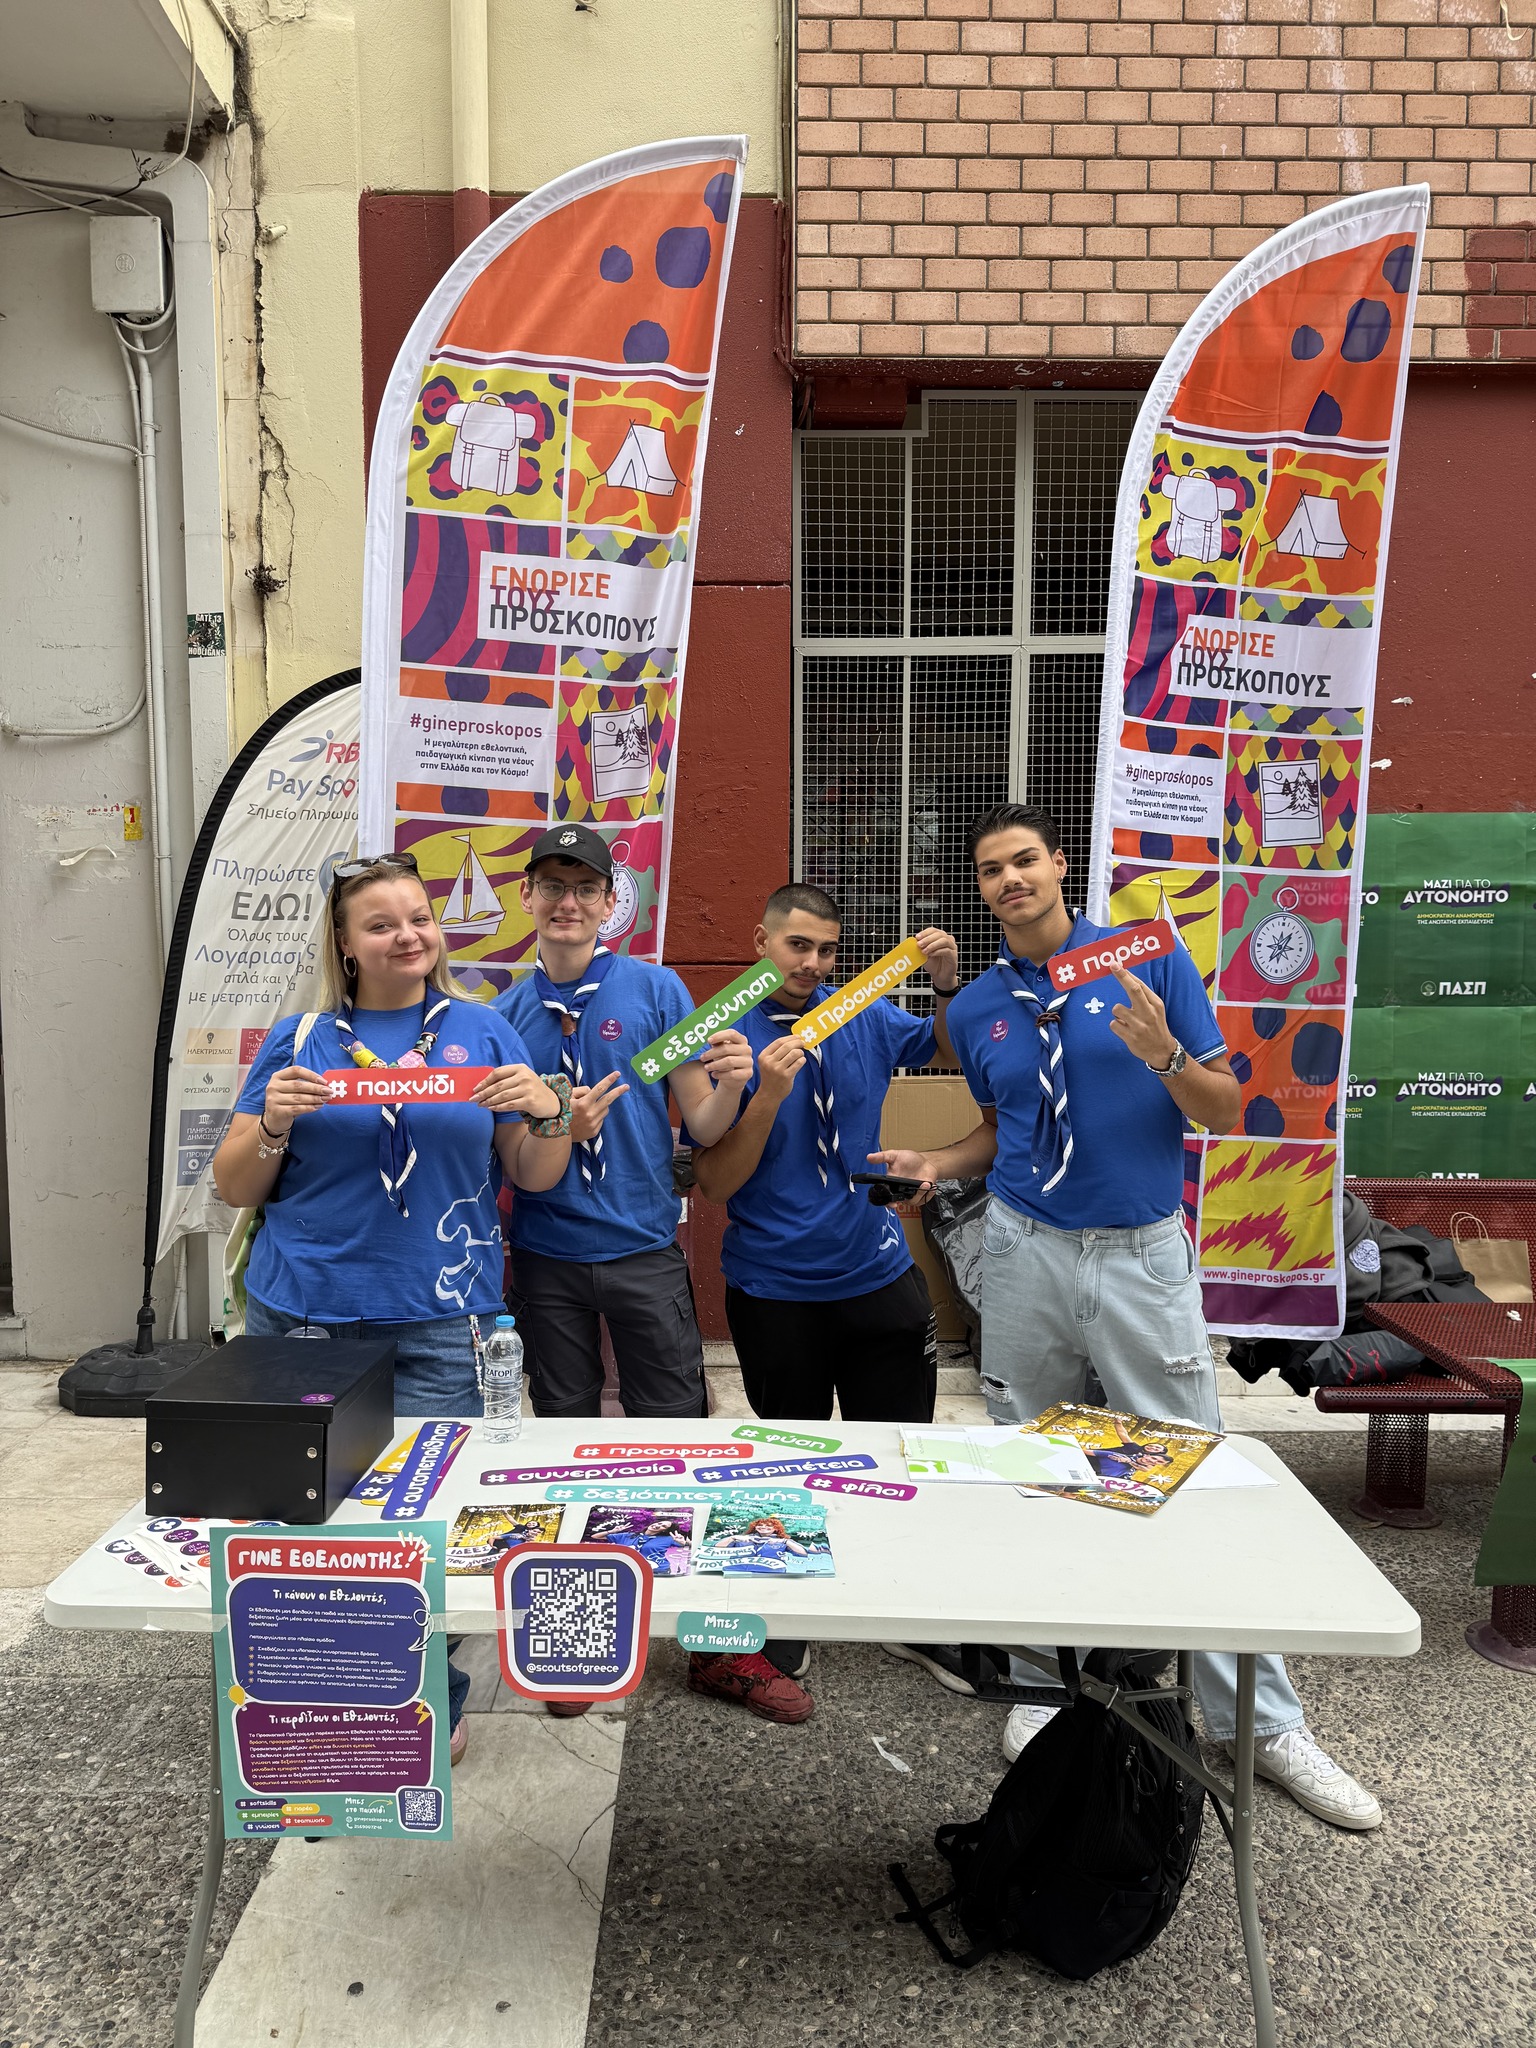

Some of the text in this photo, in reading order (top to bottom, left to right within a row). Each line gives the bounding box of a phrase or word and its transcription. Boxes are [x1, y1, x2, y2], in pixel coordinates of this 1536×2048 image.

[489, 584, 560, 614] ΤΟΥΣ
[489, 603, 658, 643] ΠΡΟΣΚΟΠΟΥΣ
[1179, 643, 1233, 671] ΤΟΥΣ
[1177, 661, 1331, 698] ΠΡΟΣΚΟΠΟΥΣ
[410, 712, 542, 741] #gineproskopos
[325, 742, 360, 764] RB
[424, 737, 527, 755] Η μεγαλύτερη εθελοντική,
[415, 749, 535, 768] παιδαγωγική κίνηση για νέους
[420, 761, 529, 778] στην Ελλάδα και τον Κόσμο!
[1126, 763, 1214, 788] #gineproskopos
[267, 769, 312, 804] Pay
[1131, 786, 1137, 795] Η
[1137, 787, 1169, 800] μεγαλύτερη
[247, 803, 297, 822] Σημείο
[1178, 804, 1188, 814] για
[1189, 803, 1208, 814] νέους
[1180, 814, 1204, 825] Κόσμο!
[212, 859, 316, 887] Πληρώστε
[1423, 879, 1491, 889] ΜΑΖΙ ΓΙΑ ΤΟ
[1402, 889, 1509, 904] ΑΥΤΟΝΟΗΤΟ
[231, 891, 313, 921] ΕΔΩ!
[227, 928, 308, 944] Όλους τους
[224, 971, 281, 985] απλά και
[817, 954, 912, 1031] Πρόσκοποι
[1439, 981, 1487, 996] ΠΑΣΠ
[189, 990, 282, 1006] με μετρητά ή
[663, 971, 778, 1062] εξερεύνηση
[187, 1047, 233, 1056] ΗΛΕΚΤΡΙΣΜΟΣ
[357, 1073, 455, 1097] παιχνίδι
[1418, 1072, 1484, 1082] ΜΑΖΙ ΓΙΑ ΤΟ
[184, 1086, 231, 1095] ΦΥΣΙΚΟ ΑΕΡΙΟ
[1397, 1082, 1502, 1097] ΑΥΤΟΝΟΗΤΟ
[187, 1150, 211, 1159] ΠΡΟΜΗ
[1203, 1269, 1325, 1285] www.gineproskopos.gr
[765, 1431, 827, 1451] φύση
[609, 1445, 740, 1459] προσφορά
[402, 1422, 453, 1504] αυτοπεποίθηση
[731, 1458, 865, 1480] περιπέτεια
[517, 1462, 676, 1482] συνεργασία
[583, 1486, 723, 1503] δεξιότητες
[729, 1486, 802, 1502] ζωής
[841, 1479, 906, 1498] φίλοι
[238, 1548, 418, 1570] ΓΙΝΕ ΕΘΕΛΟΝΤΗΣ!
[273, 1587, 387, 1605] Τι κάνουν οι Εθελοντές;
[704, 1615, 740, 1630] Μπες
[683, 1633, 704, 1645] στο
[526, 1662, 620, 1676] @scoutsofgreece
[269, 1709, 399, 1730] Τι κερδίζουν οι Εθελοντές;
[249, 1799, 277, 1807] softskills
[294, 1804, 313, 1813] παρέα
[294, 1817, 325, 1825] teamwork
